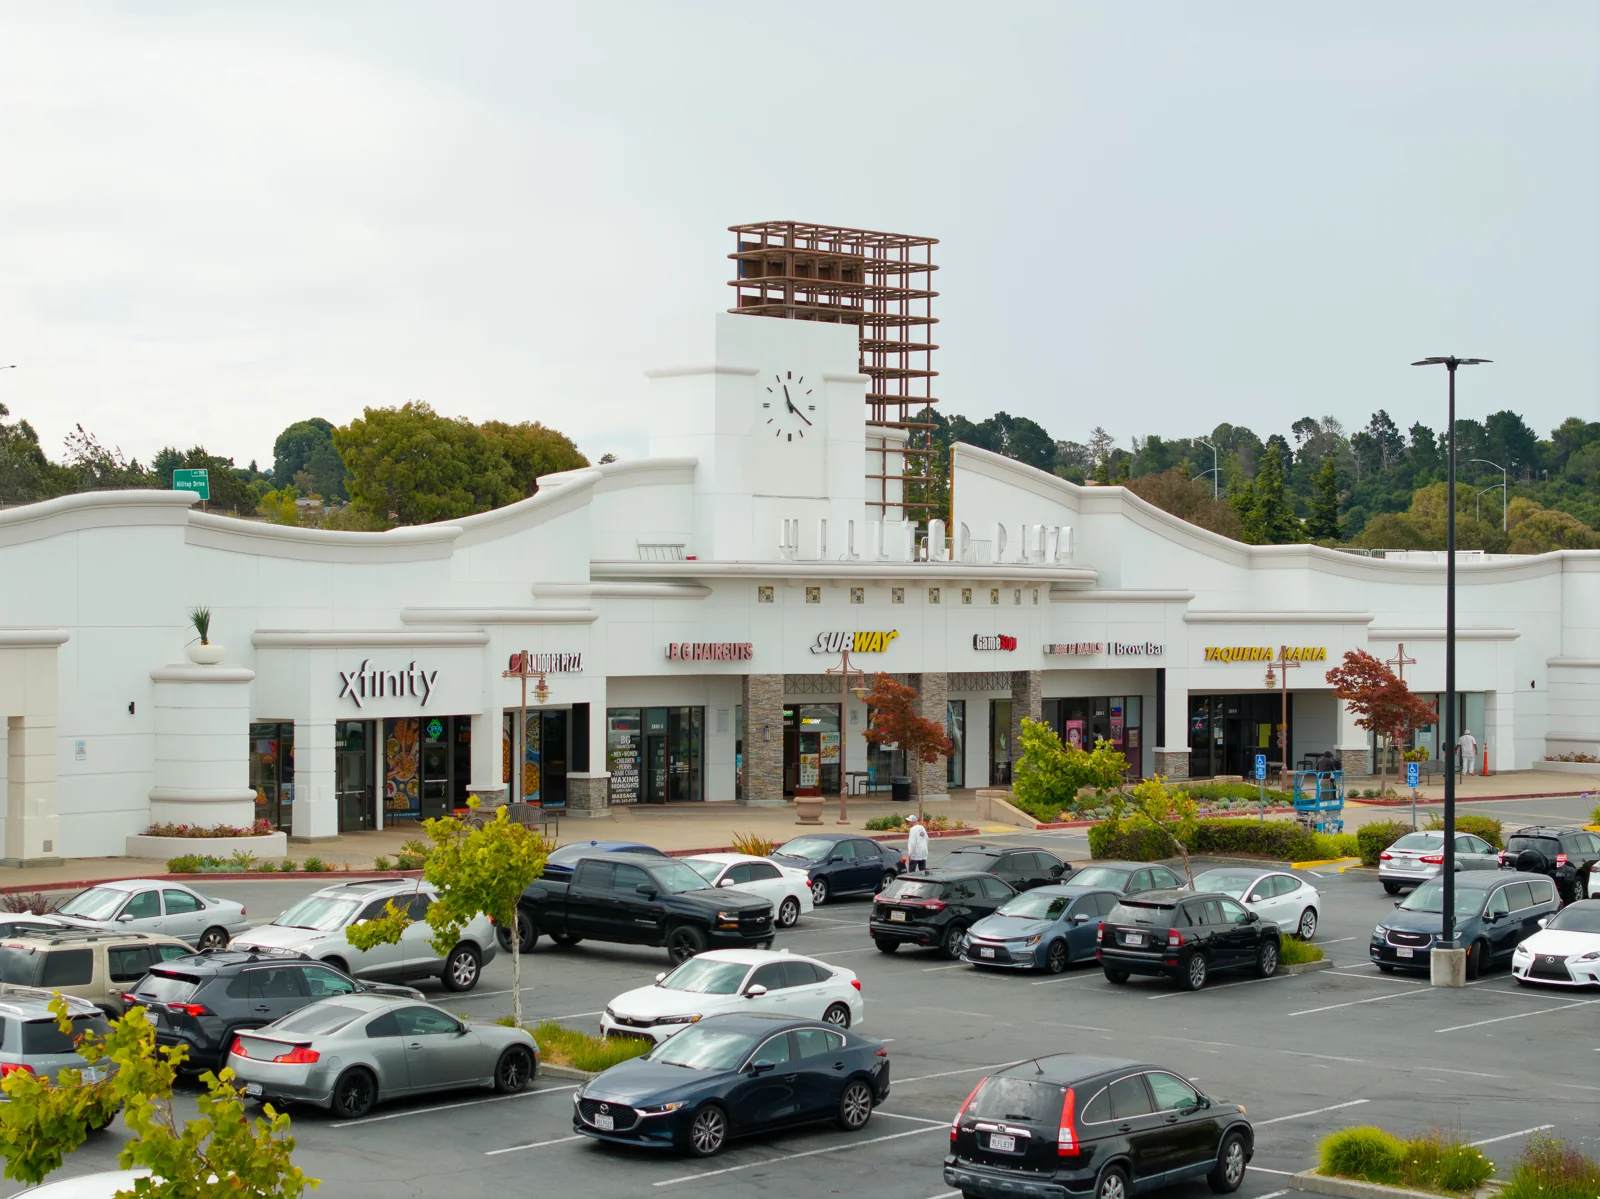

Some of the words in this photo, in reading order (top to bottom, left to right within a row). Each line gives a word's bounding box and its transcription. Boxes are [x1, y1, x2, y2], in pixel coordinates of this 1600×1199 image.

[810, 630, 899, 654] SUBWAY
[974, 634, 1017, 652] GameStop
[1077, 642, 1103, 655] NAILS
[1115, 642, 1144, 655] Brow
[1146, 642, 1165, 655] Bar
[693, 643, 753, 660] HAIRCUTS
[1205, 647, 1273, 663] TAQUERIA
[339, 658, 439, 708] xfinity
[426, 724, 443, 733] OPEN
[620, 736, 631, 744] BG
